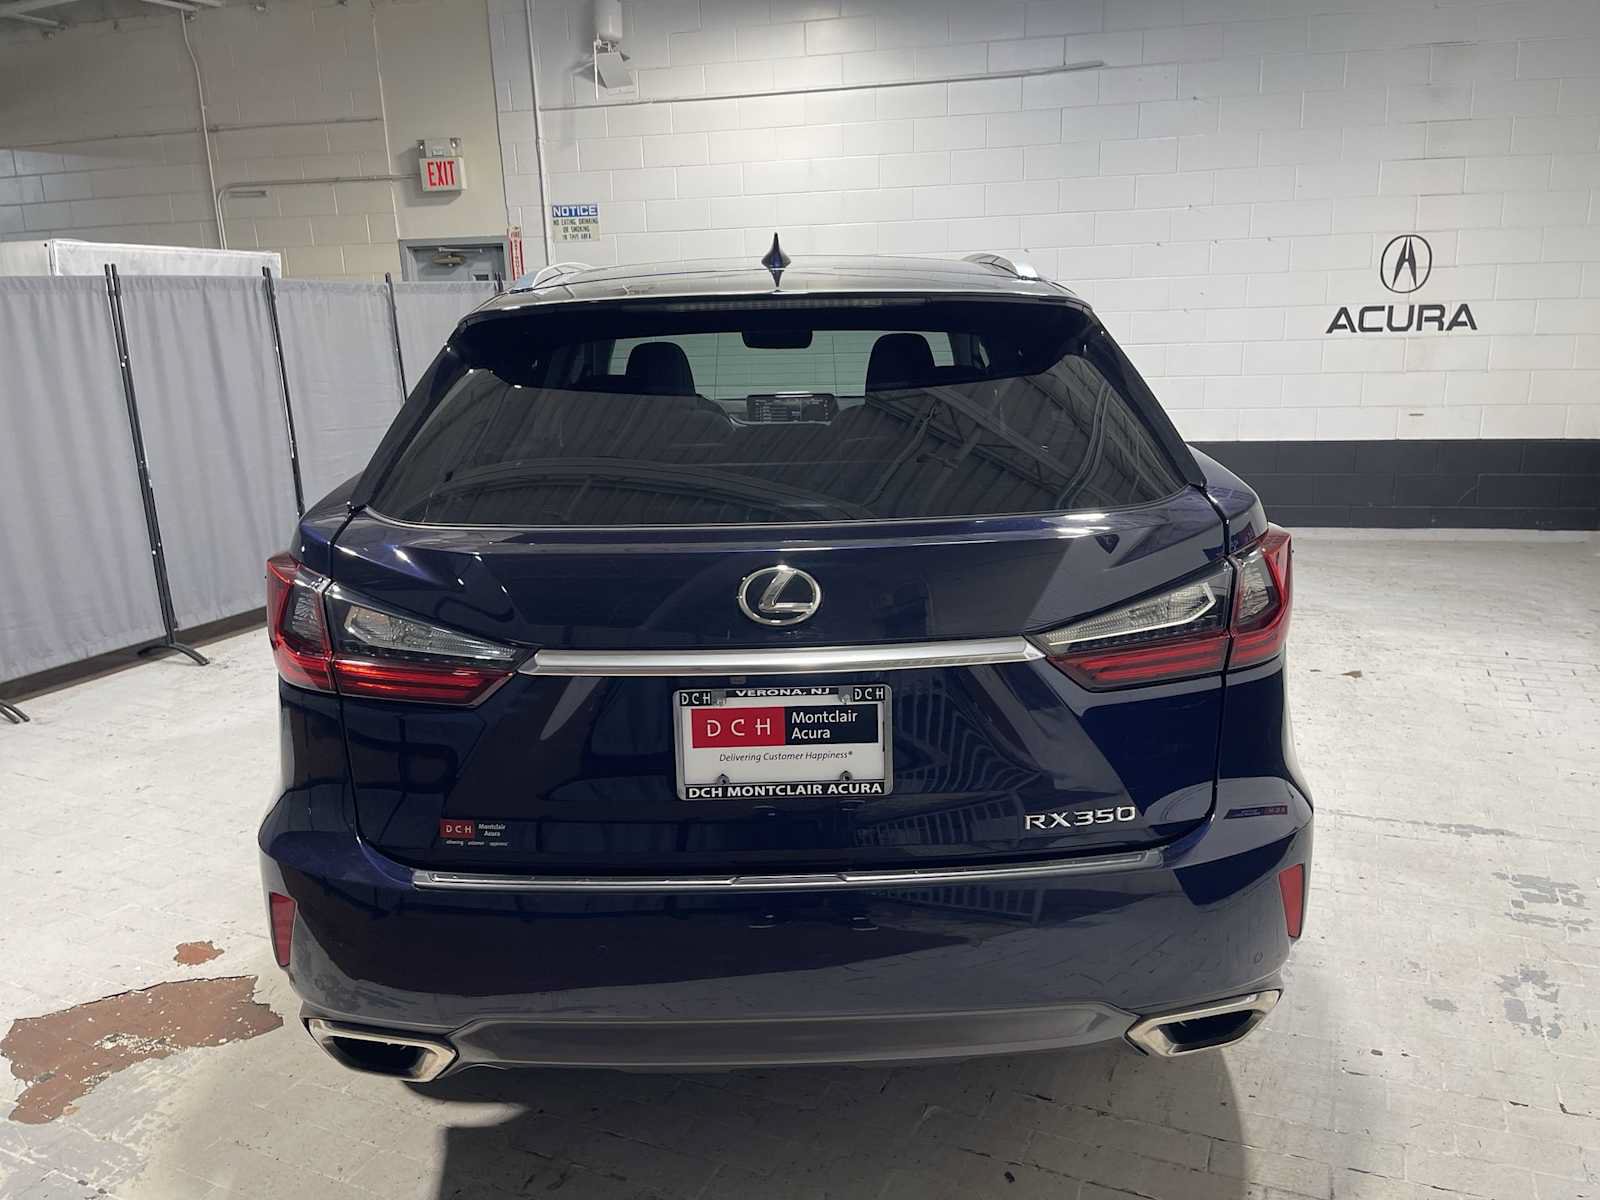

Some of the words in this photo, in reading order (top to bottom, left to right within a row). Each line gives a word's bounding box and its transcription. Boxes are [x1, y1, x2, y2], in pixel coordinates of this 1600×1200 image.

[427, 160, 456, 187] EXIT
[553, 205, 597, 217] NOTICE
[570, 225, 591, 233] SMOKING
[1326, 303, 1478, 334] ACURA
[811, 687, 830, 695] NJ
[791, 709, 858, 724] Montclair
[706, 717, 771, 738] DCH
[791, 726, 831, 740] Acura
[719, 752, 762, 763] Delivering
[763, 751, 804, 761] Customer
[688, 787, 722, 799] DCH
[726, 784, 823, 798] MONTCLAIR
[828, 782, 882, 796] ACURA
[1024, 812, 1072, 830] RX
[1073, 806, 1137, 826] 350
